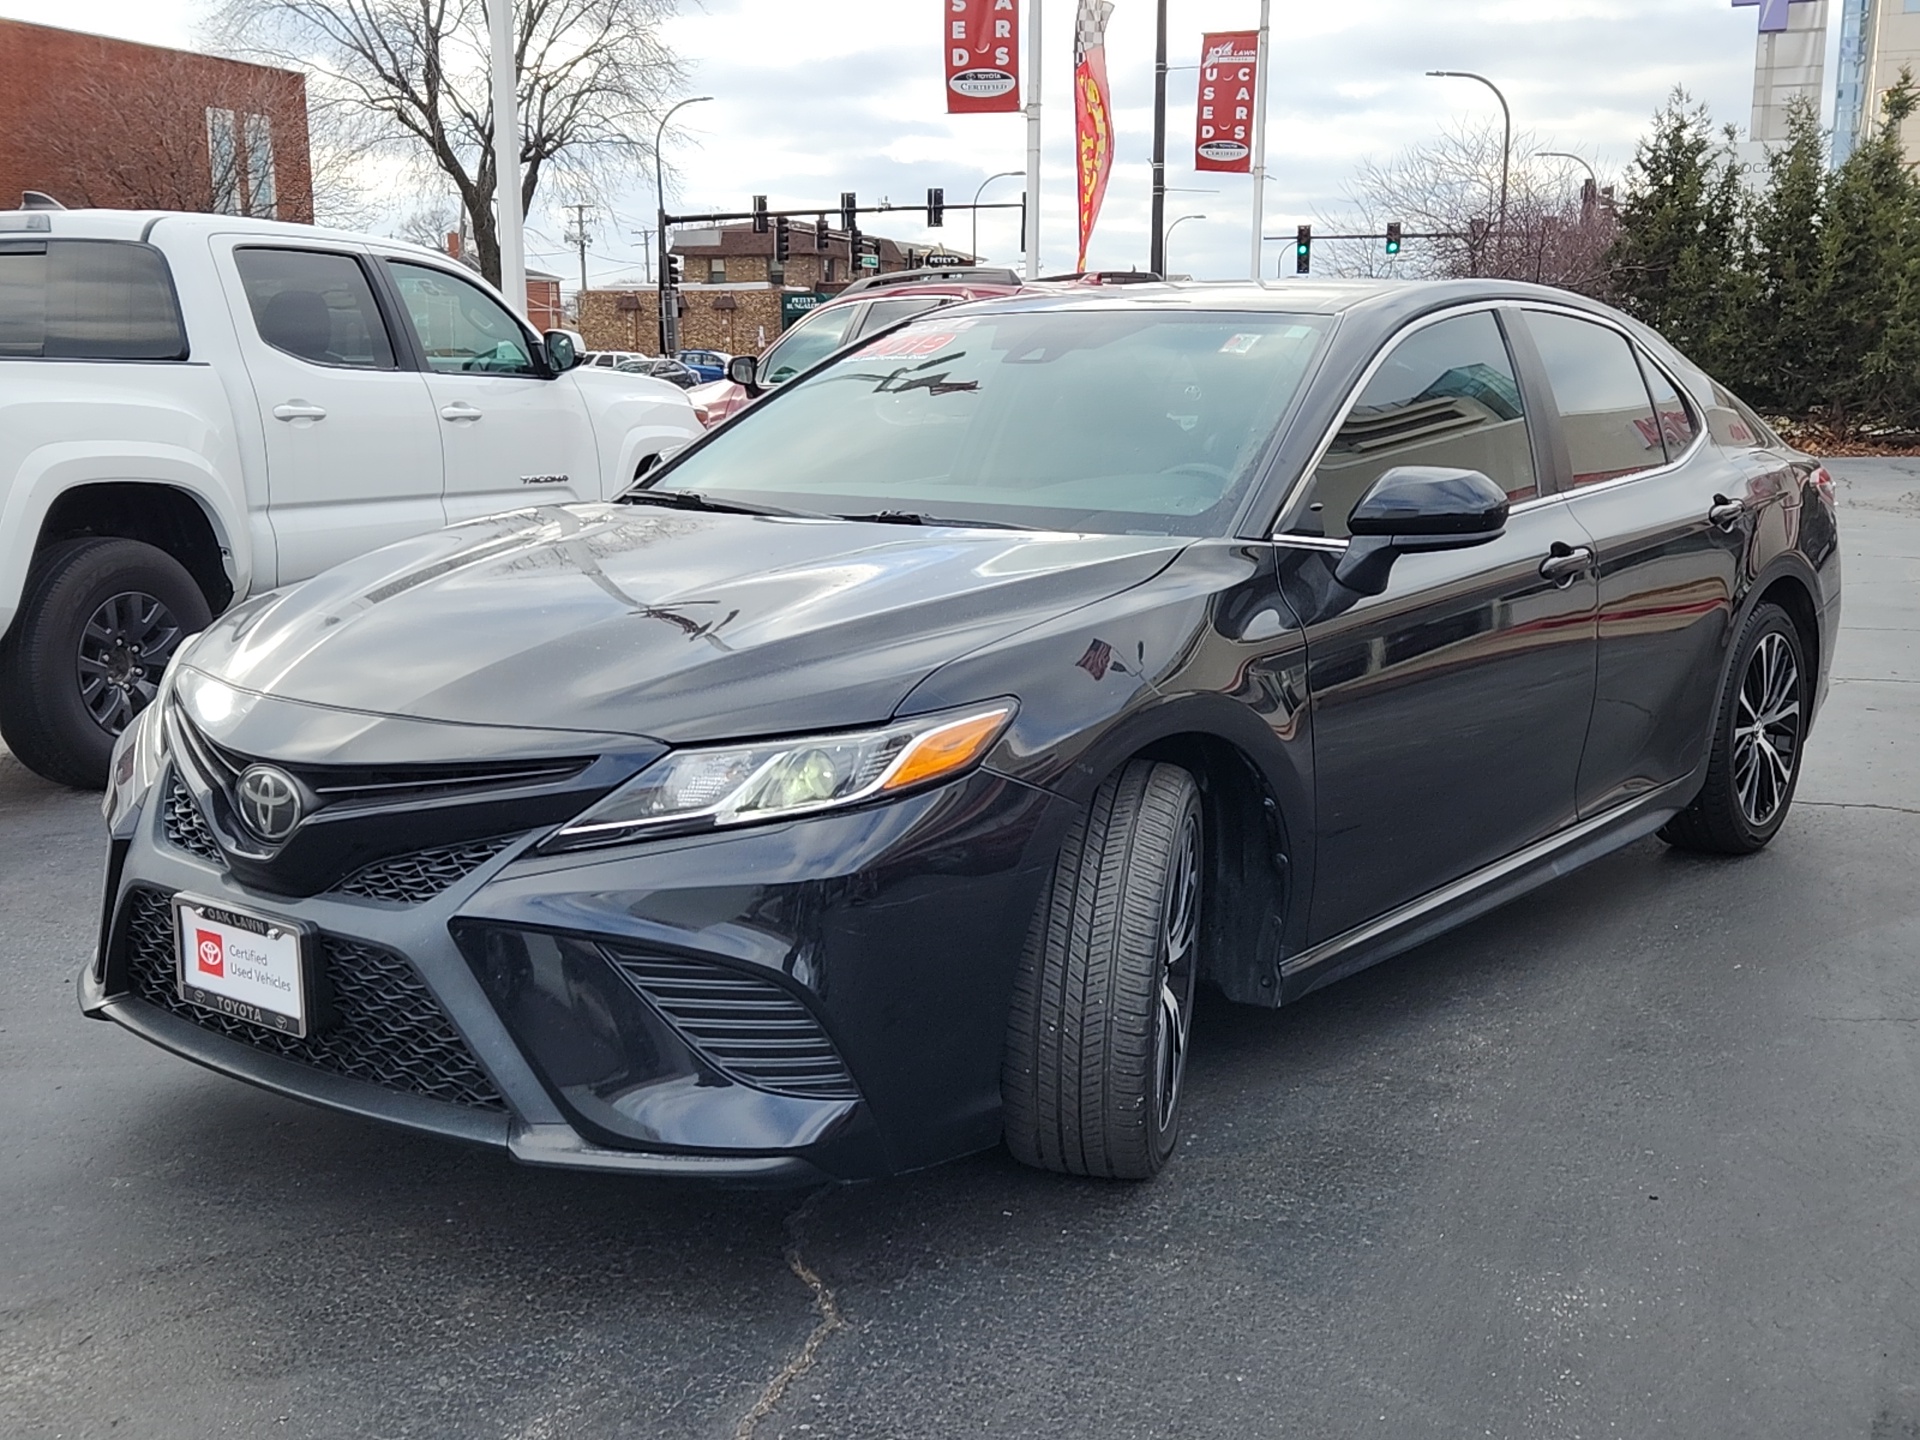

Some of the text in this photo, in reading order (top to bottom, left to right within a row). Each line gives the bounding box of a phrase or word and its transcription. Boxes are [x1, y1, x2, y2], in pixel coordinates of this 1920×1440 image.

[1201, 68, 1218, 139] USED
[1234, 68, 1251, 140] CARS
[929, 256, 959, 264] PETEY'S
[520, 475, 569, 485] TACOMA
[207, 907, 265, 935] OAK LAWN
[229, 944, 268, 966] Certified
[230, 962, 292, 992] Used Vehicles
[216, 996, 262, 1022] TOYOTA
